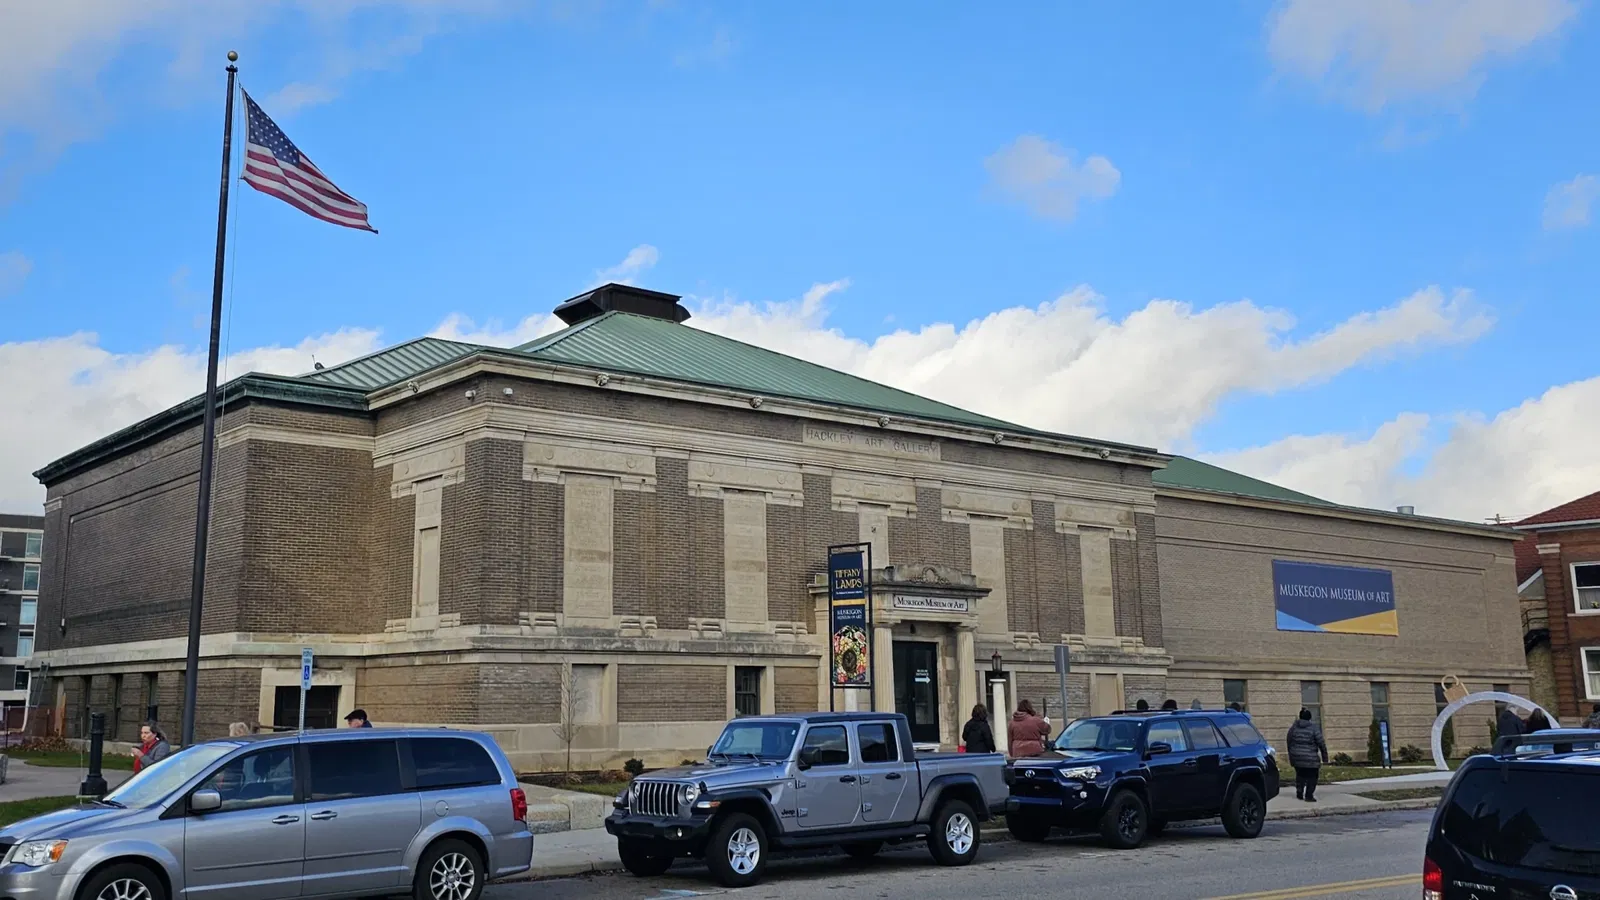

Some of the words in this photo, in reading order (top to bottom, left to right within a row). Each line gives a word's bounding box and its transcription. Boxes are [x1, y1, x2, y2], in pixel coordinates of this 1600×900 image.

[806, 428, 853, 444] HACKLEY
[865, 437, 883, 448] ART
[893, 441, 937, 455] GALLERY
[834, 569, 861, 578] TIFFANY
[836, 579, 862, 590] LAMPS
[1280, 584, 1328, 599] MUSKEGON
[1330, 587, 1365, 602] MUSEUM
[1375, 591, 1390, 603] ART
[1453, 880, 1496, 893] PATHFINDER
